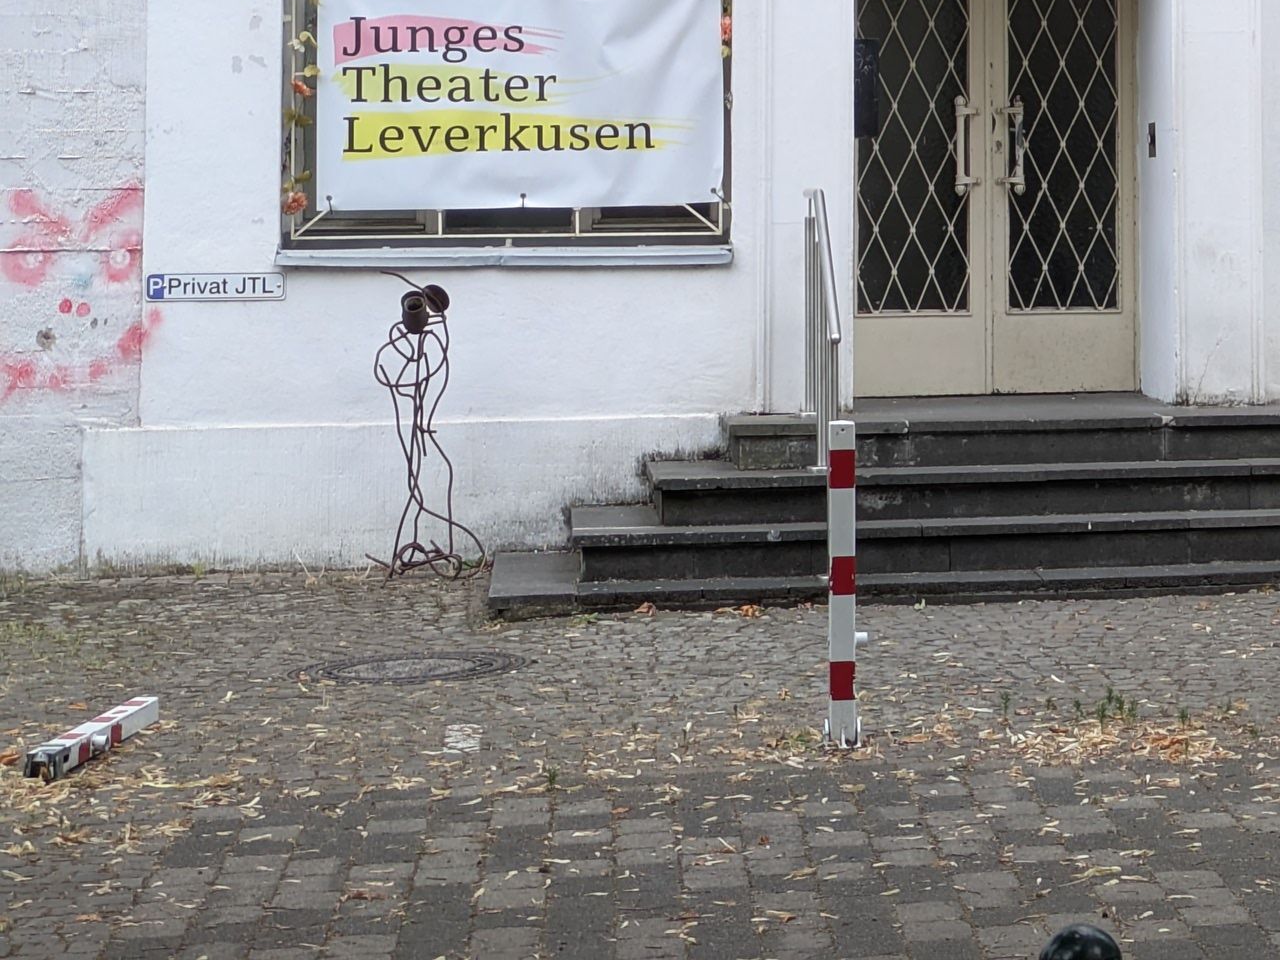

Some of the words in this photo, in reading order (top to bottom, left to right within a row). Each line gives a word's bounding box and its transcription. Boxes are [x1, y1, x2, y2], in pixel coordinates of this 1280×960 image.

[342, 16, 525, 63] Junges
[342, 63, 557, 103] Theater
[343, 112, 655, 153] Leverkusen
[167, 277, 228, 295] Privat
[235, 276, 274, 295] JTL
